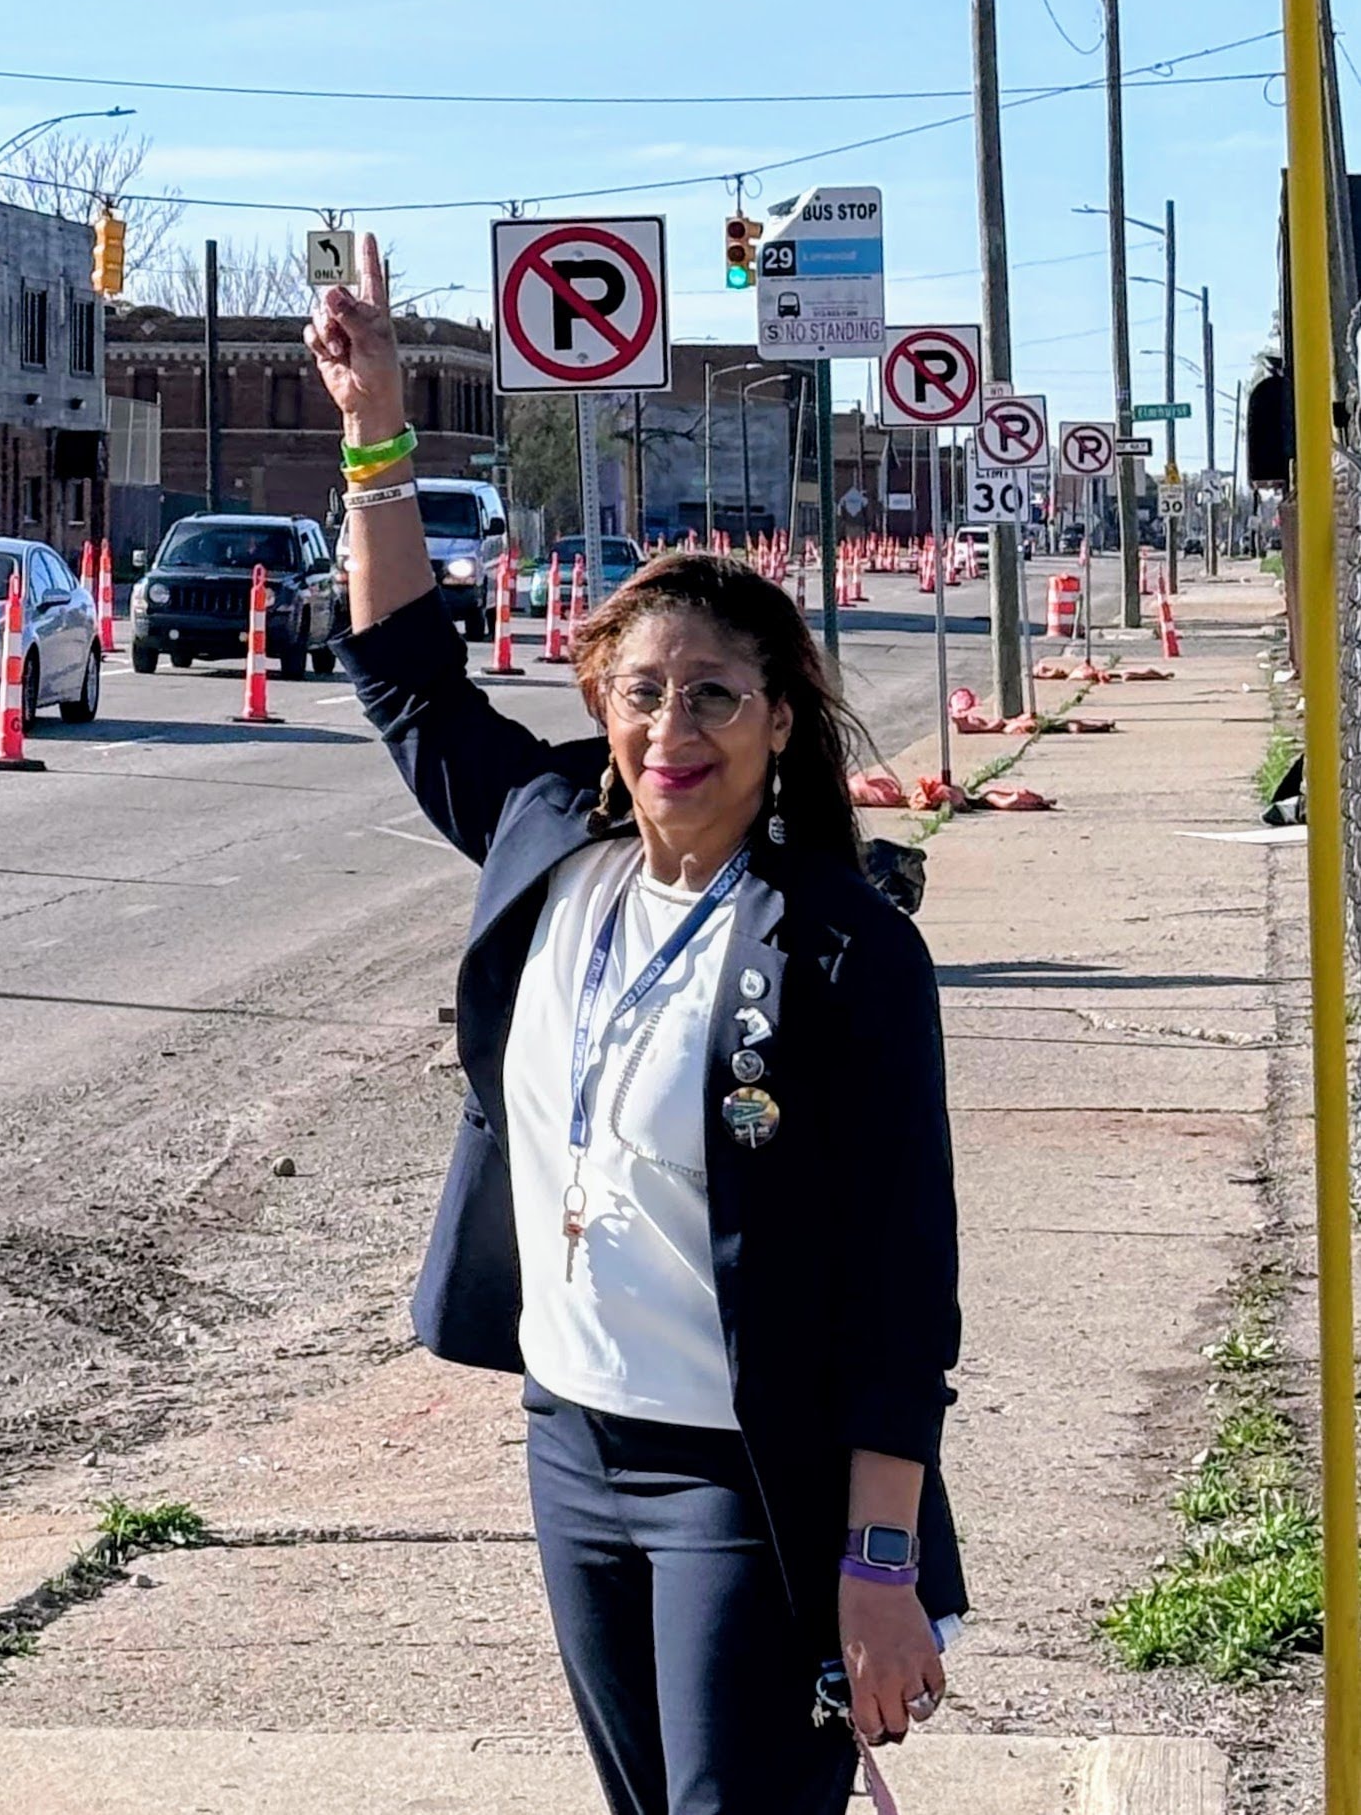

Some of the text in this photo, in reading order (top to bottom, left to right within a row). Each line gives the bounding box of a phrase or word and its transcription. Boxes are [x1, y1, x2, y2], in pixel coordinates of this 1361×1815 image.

[802, 202, 877, 221] BUS STOP
[764, 247, 794, 270] 29
[314, 269, 344, 281] ONLY
[785, 322, 806, 342] NO
[810, 321, 880, 341] STANDING
[973, 483, 1024, 514] 30
[1161, 500, 1183, 513] 30
